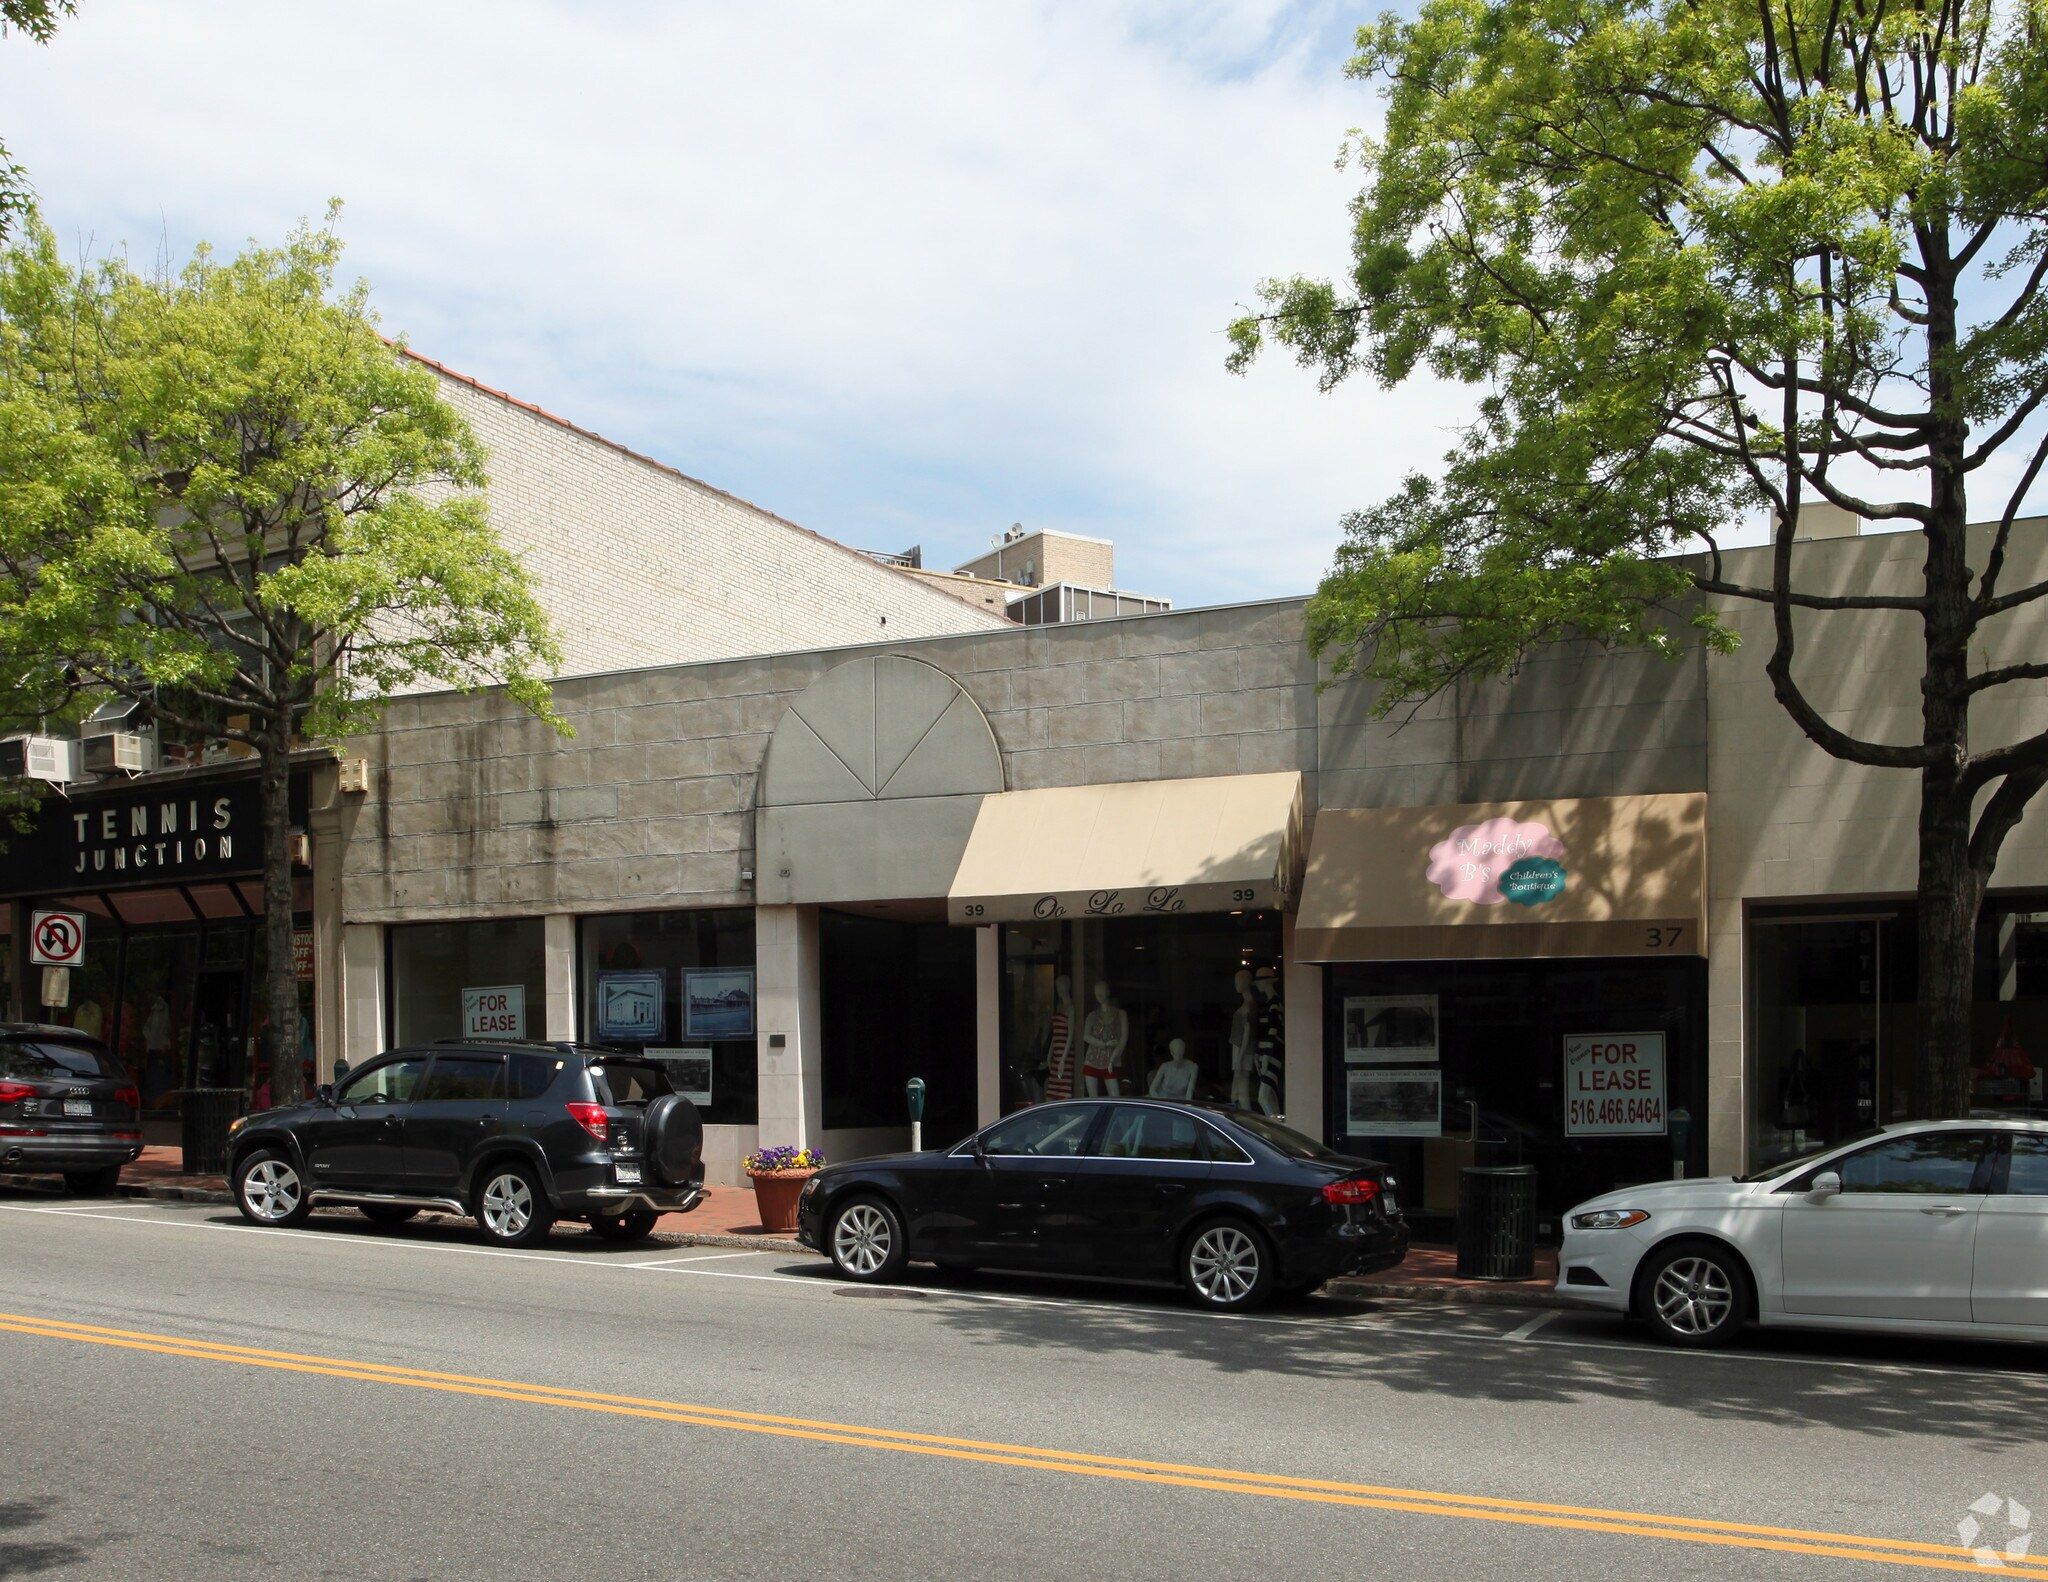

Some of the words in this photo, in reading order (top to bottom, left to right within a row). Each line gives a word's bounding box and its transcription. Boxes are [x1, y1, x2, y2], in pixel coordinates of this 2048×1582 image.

[73, 797, 232, 843] TENNIS
[74, 835, 232, 873] JUNCTION
[1456, 834, 1533, 858] Maddy
[1460, 861, 1491, 883] B's
[1509, 870, 1559, 881] Children's
[1509, 882, 1557, 891] Boutique
[964, 905, 985, 916] 39
[1033, 896, 1066, 919] Oo
[1084, 889, 1125, 915] La
[1143, 886, 1185, 912] La
[1232, 889, 1255, 901] 39
[1646, 927, 1683, 947] 37
[479, 995, 507, 1011] FOR
[472, 1014, 517, 1032] LEASE
[1591, 1043, 1637, 1065] FOR
[1579, 1069, 1651, 1091] LEASE
[1570, 1097, 1661, 1125] 516.466.6464
